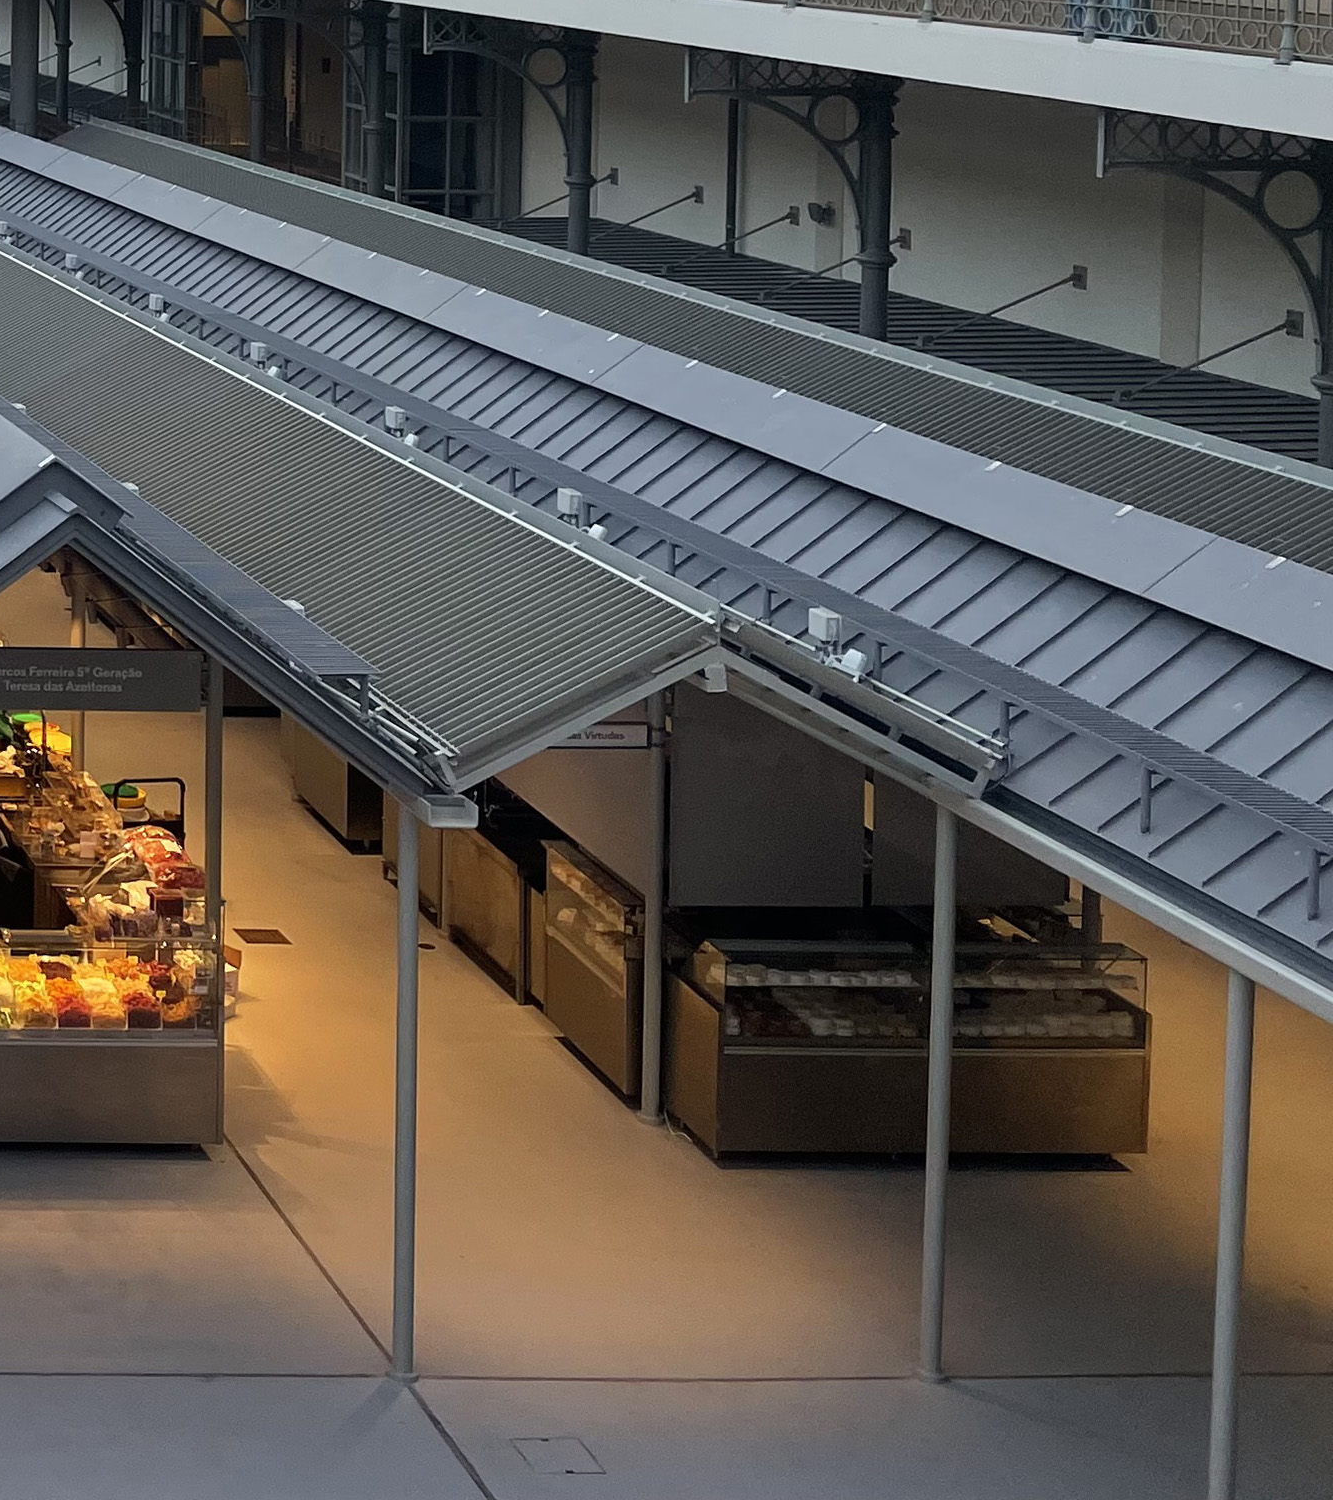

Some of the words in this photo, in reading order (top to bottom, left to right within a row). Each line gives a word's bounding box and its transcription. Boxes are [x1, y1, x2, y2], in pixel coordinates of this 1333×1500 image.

[29, 665, 75, 678] Ferreira
[93, 666, 143, 680] Geração
[3, 679, 40, 691] Teresa
[43, 680, 64, 692] das
[66, 680, 123, 693] Azeitonas
[584, 731, 626, 740] Virtudes
